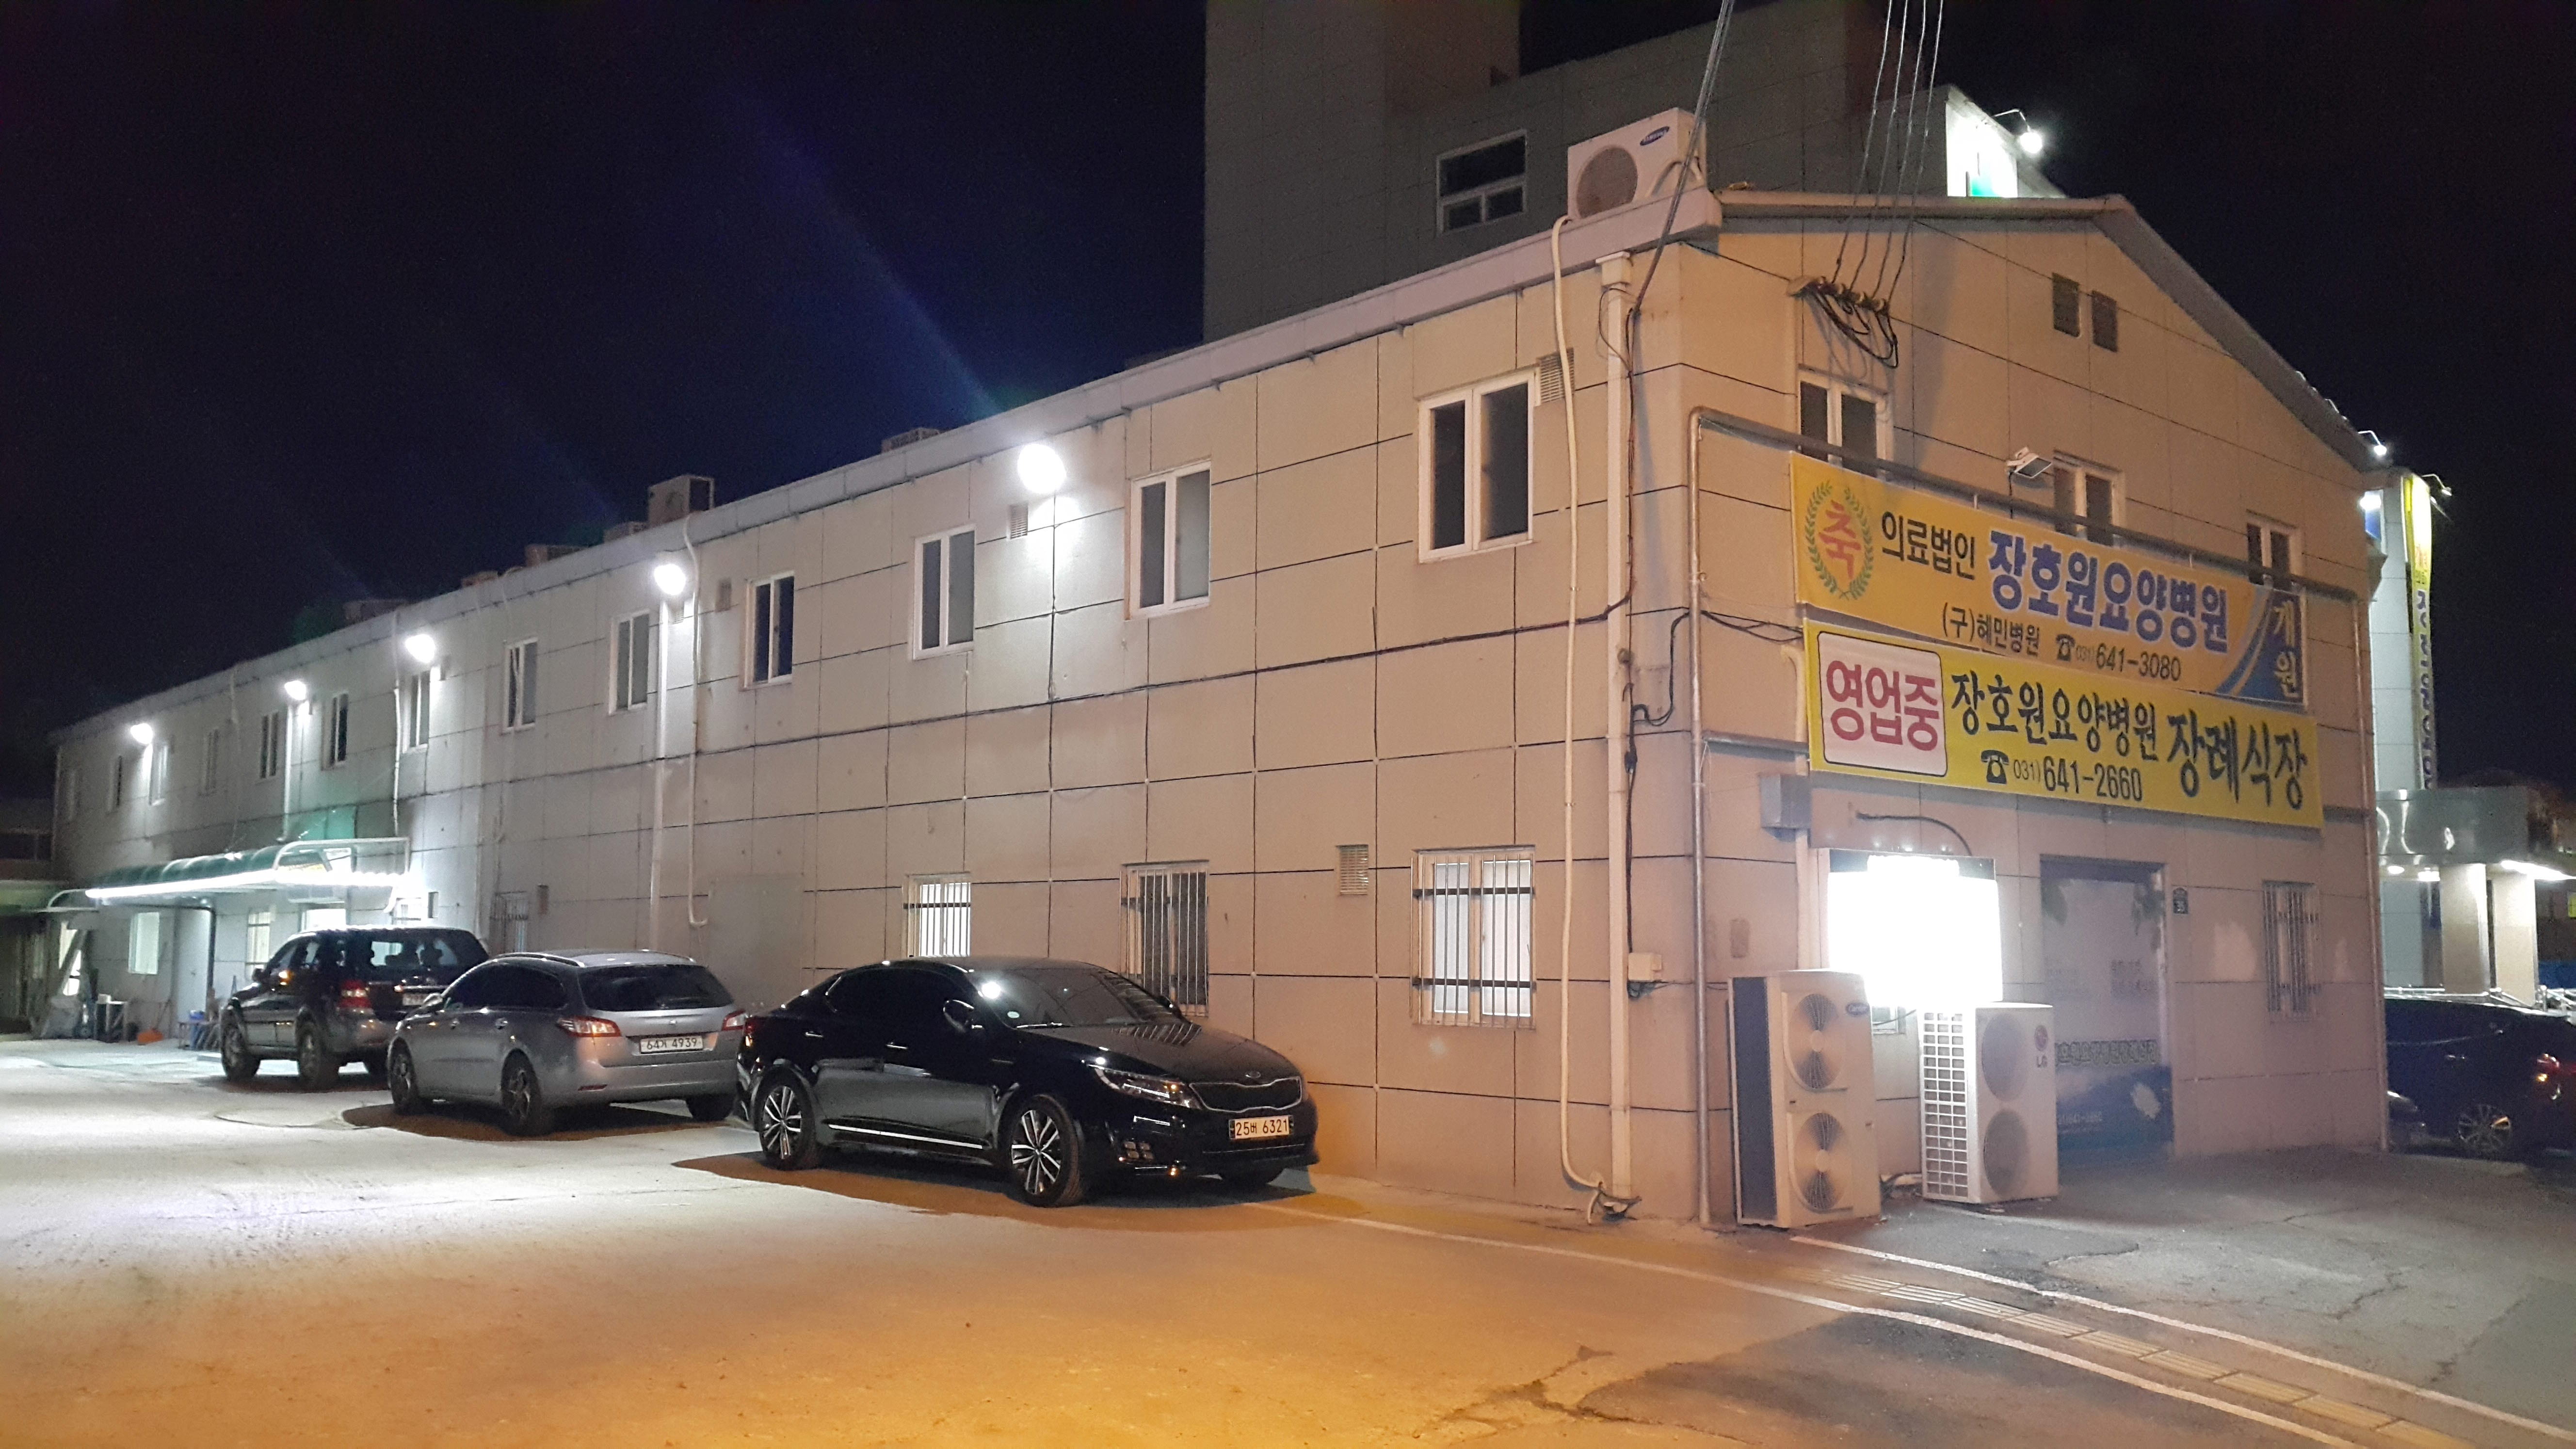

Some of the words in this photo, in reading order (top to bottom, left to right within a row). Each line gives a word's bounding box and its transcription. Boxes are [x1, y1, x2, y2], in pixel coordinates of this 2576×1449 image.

[1819, 499, 1862, 580] 축
[1882, 511, 1975, 580] 의료법인
[1988, 530, 2228, 653] 장호원요양병원
[1942, 602, 2040, 657] (구)혜민병원
[2273, 599, 2299, 698] 개원
[1826, 660, 1940, 751] 영업중
[1951, 670, 2158, 762] 장호원요양병원
[2167, 708, 2308, 810] 장례식장
[672, 1037, 697, 1048] 4939
[1236, 1121, 1257, 1136] 25버
[1262, 1118, 1287, 1134] 6321
